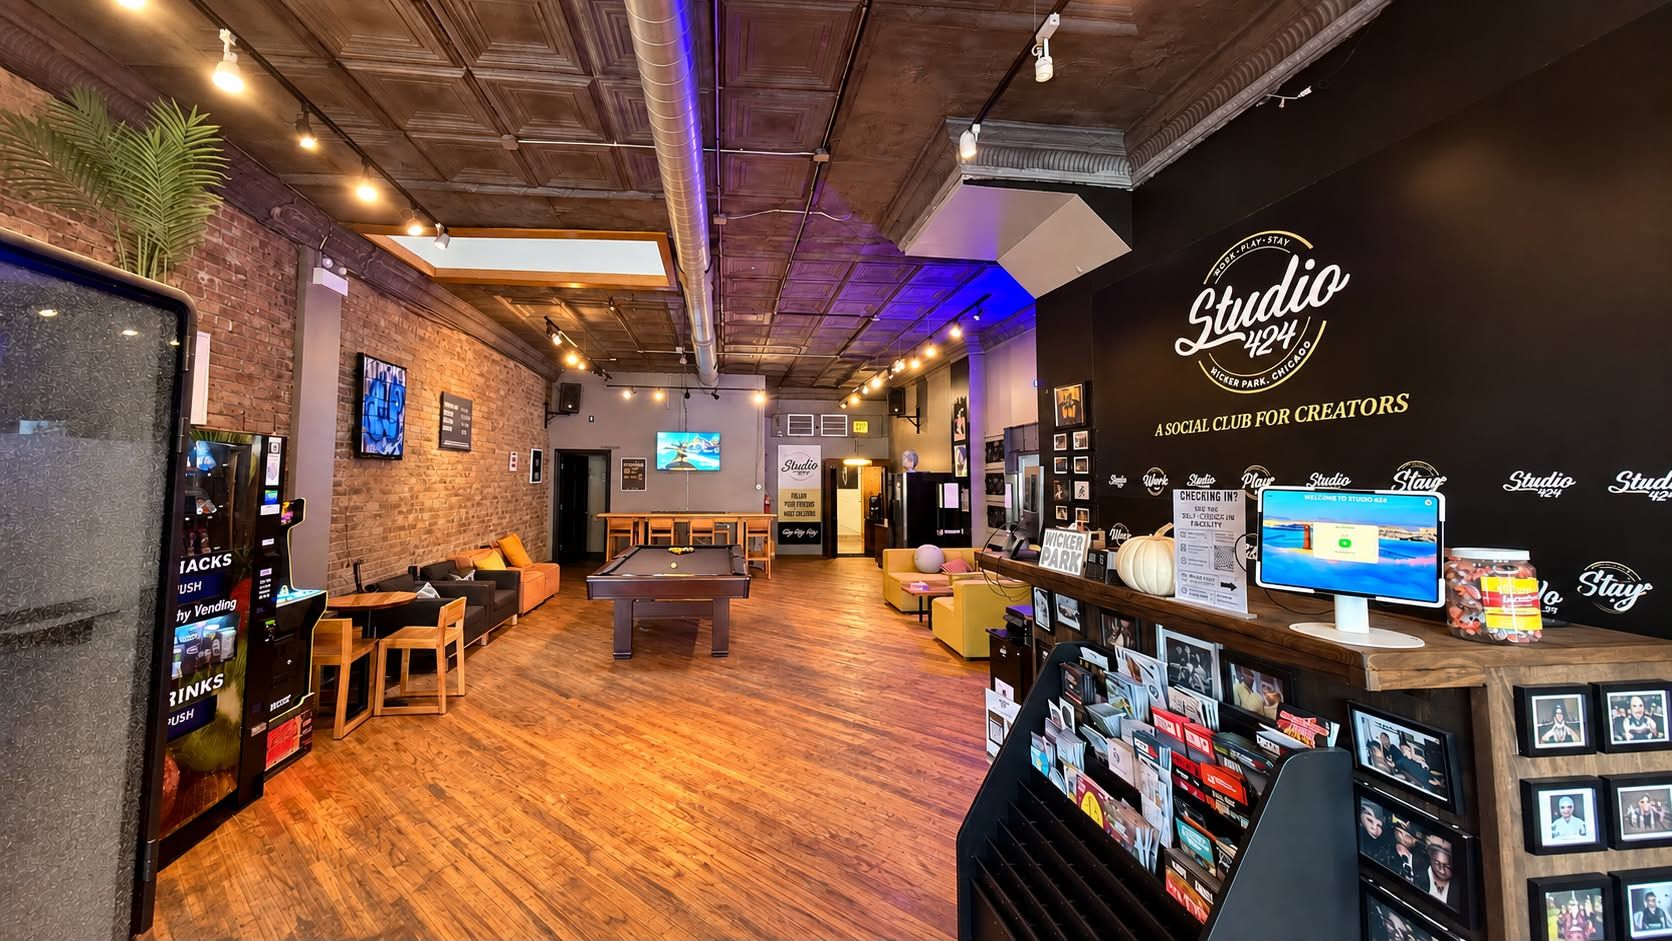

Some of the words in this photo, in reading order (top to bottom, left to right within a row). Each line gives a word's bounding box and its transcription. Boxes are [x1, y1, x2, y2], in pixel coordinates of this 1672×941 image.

[1240, 237, 1262, 256] PLAY
[1267, 235, 1291, 250] STAY
[1174, 253, 1351, 357] Studio
[1243, 318, 1298, 358] 424
[1154, 422, 1164, 437] A
[1164, 418, 1210, 436] SOCIAL
[1212, 413, 1253, 431] CLUB
[1254, 407, 1291, 428] FOR
[1294, 392, 1411, 423] CREATORS
[781, 458, 818, 473] Studio
[1143, 473, 1168, 488] Work
[1306, 472, 1352, 489] Studio
[1503, 470, 1577, 491] Studio
[1180, 490, 1221, 502] CHECKING
[1224, 491, 1239, 502] IN?
[1304, 494, 1338, 502] WELCOME
[1537, 487, 1562, 498] 424
[1044, 531, 1084, 552] WICKER
[1041, 546, 1082, 573] PARK
[177, 581, 202, 595] USH
[1577, 569, 1653, 613] Stay
[194, 599, 238, 618] Vending
